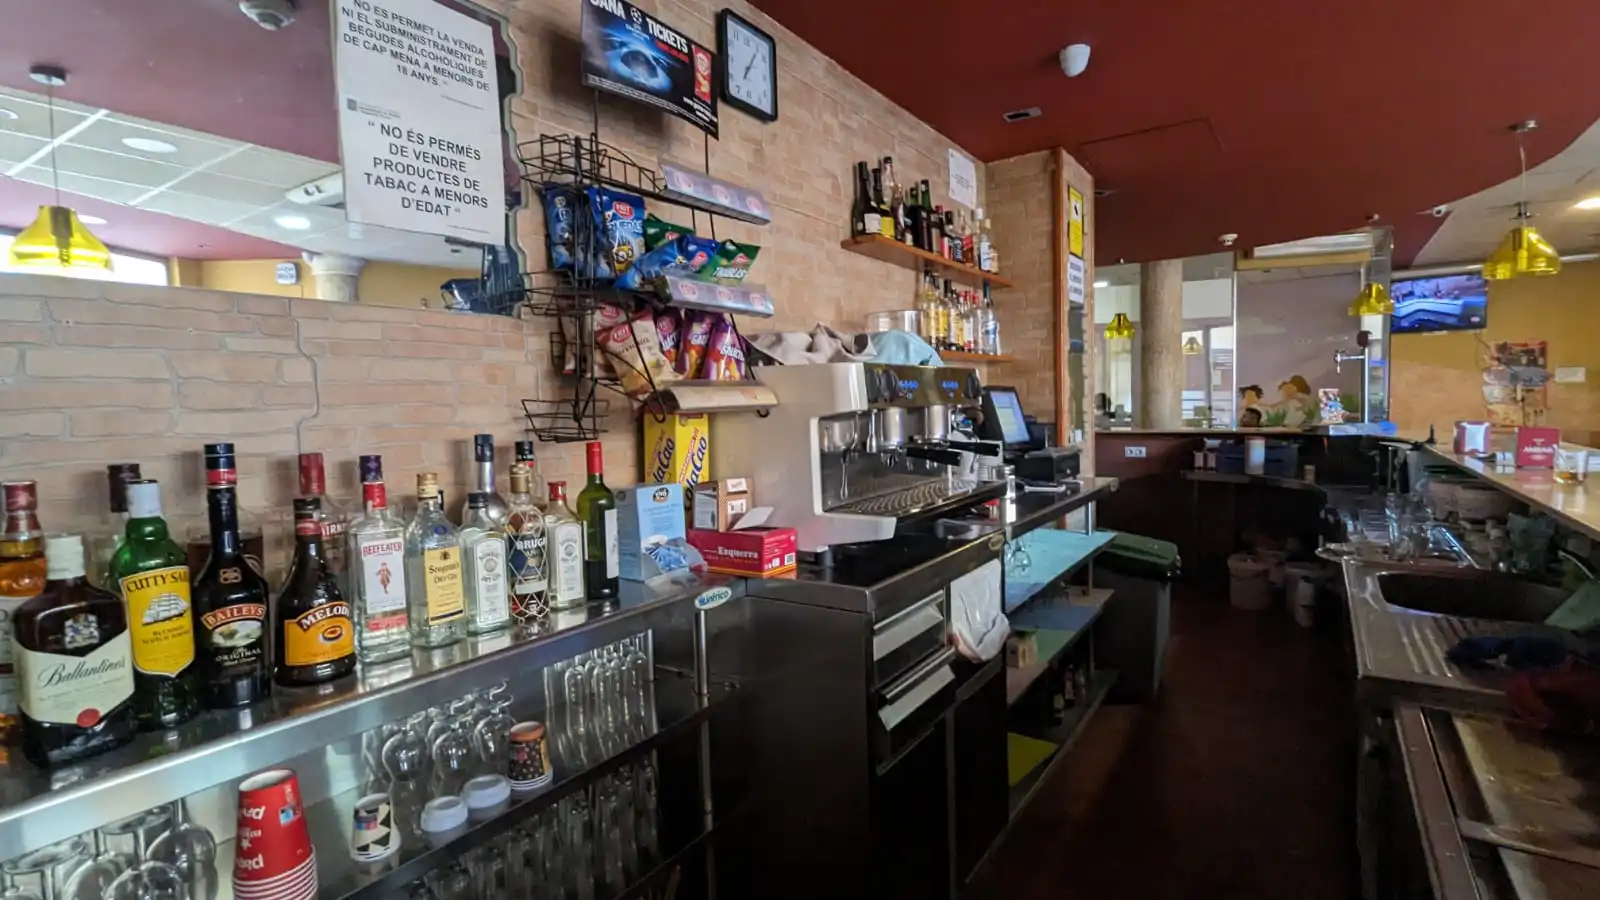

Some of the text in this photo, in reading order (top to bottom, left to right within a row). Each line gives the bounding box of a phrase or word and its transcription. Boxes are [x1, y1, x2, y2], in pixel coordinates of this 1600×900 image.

[342, 7, 488, 69] NI EL SUBMINISTRAMENT DE
[354, 0, 371, 12] NO
[391, 9, 434, 37] PERMET
[436, 28, 450, 43] LA
[452, 34, 484, 55] VENDA
[646, 18, 689, 54] TICKETS
[343, 33, 489, 92] DE CAP MENA A MENORS DE
[348, 22, 484, 79] BEGUDES ALCOHOLIQUES
[397, 65, 408, 76] 18
[380, 123, 402, 140] NO
[406, 128, 425, 146] ÉS
[373, 157, 481, 192] PRODUCTES DE
[389, 142, 467, 173] DE VENDRE
[364, 172, 488, 208] TABAC A MENORS
[685, 436, 708, 501] olaCao
[362, 541, 403, 557] BEEFEATER
[127, 572, 168, 593] CUTTY
[208, 606, 263, 625] BAILEYS
[301, 605, 350, 630] MELOD
[38, 655, 126, 688] Ballantine's
